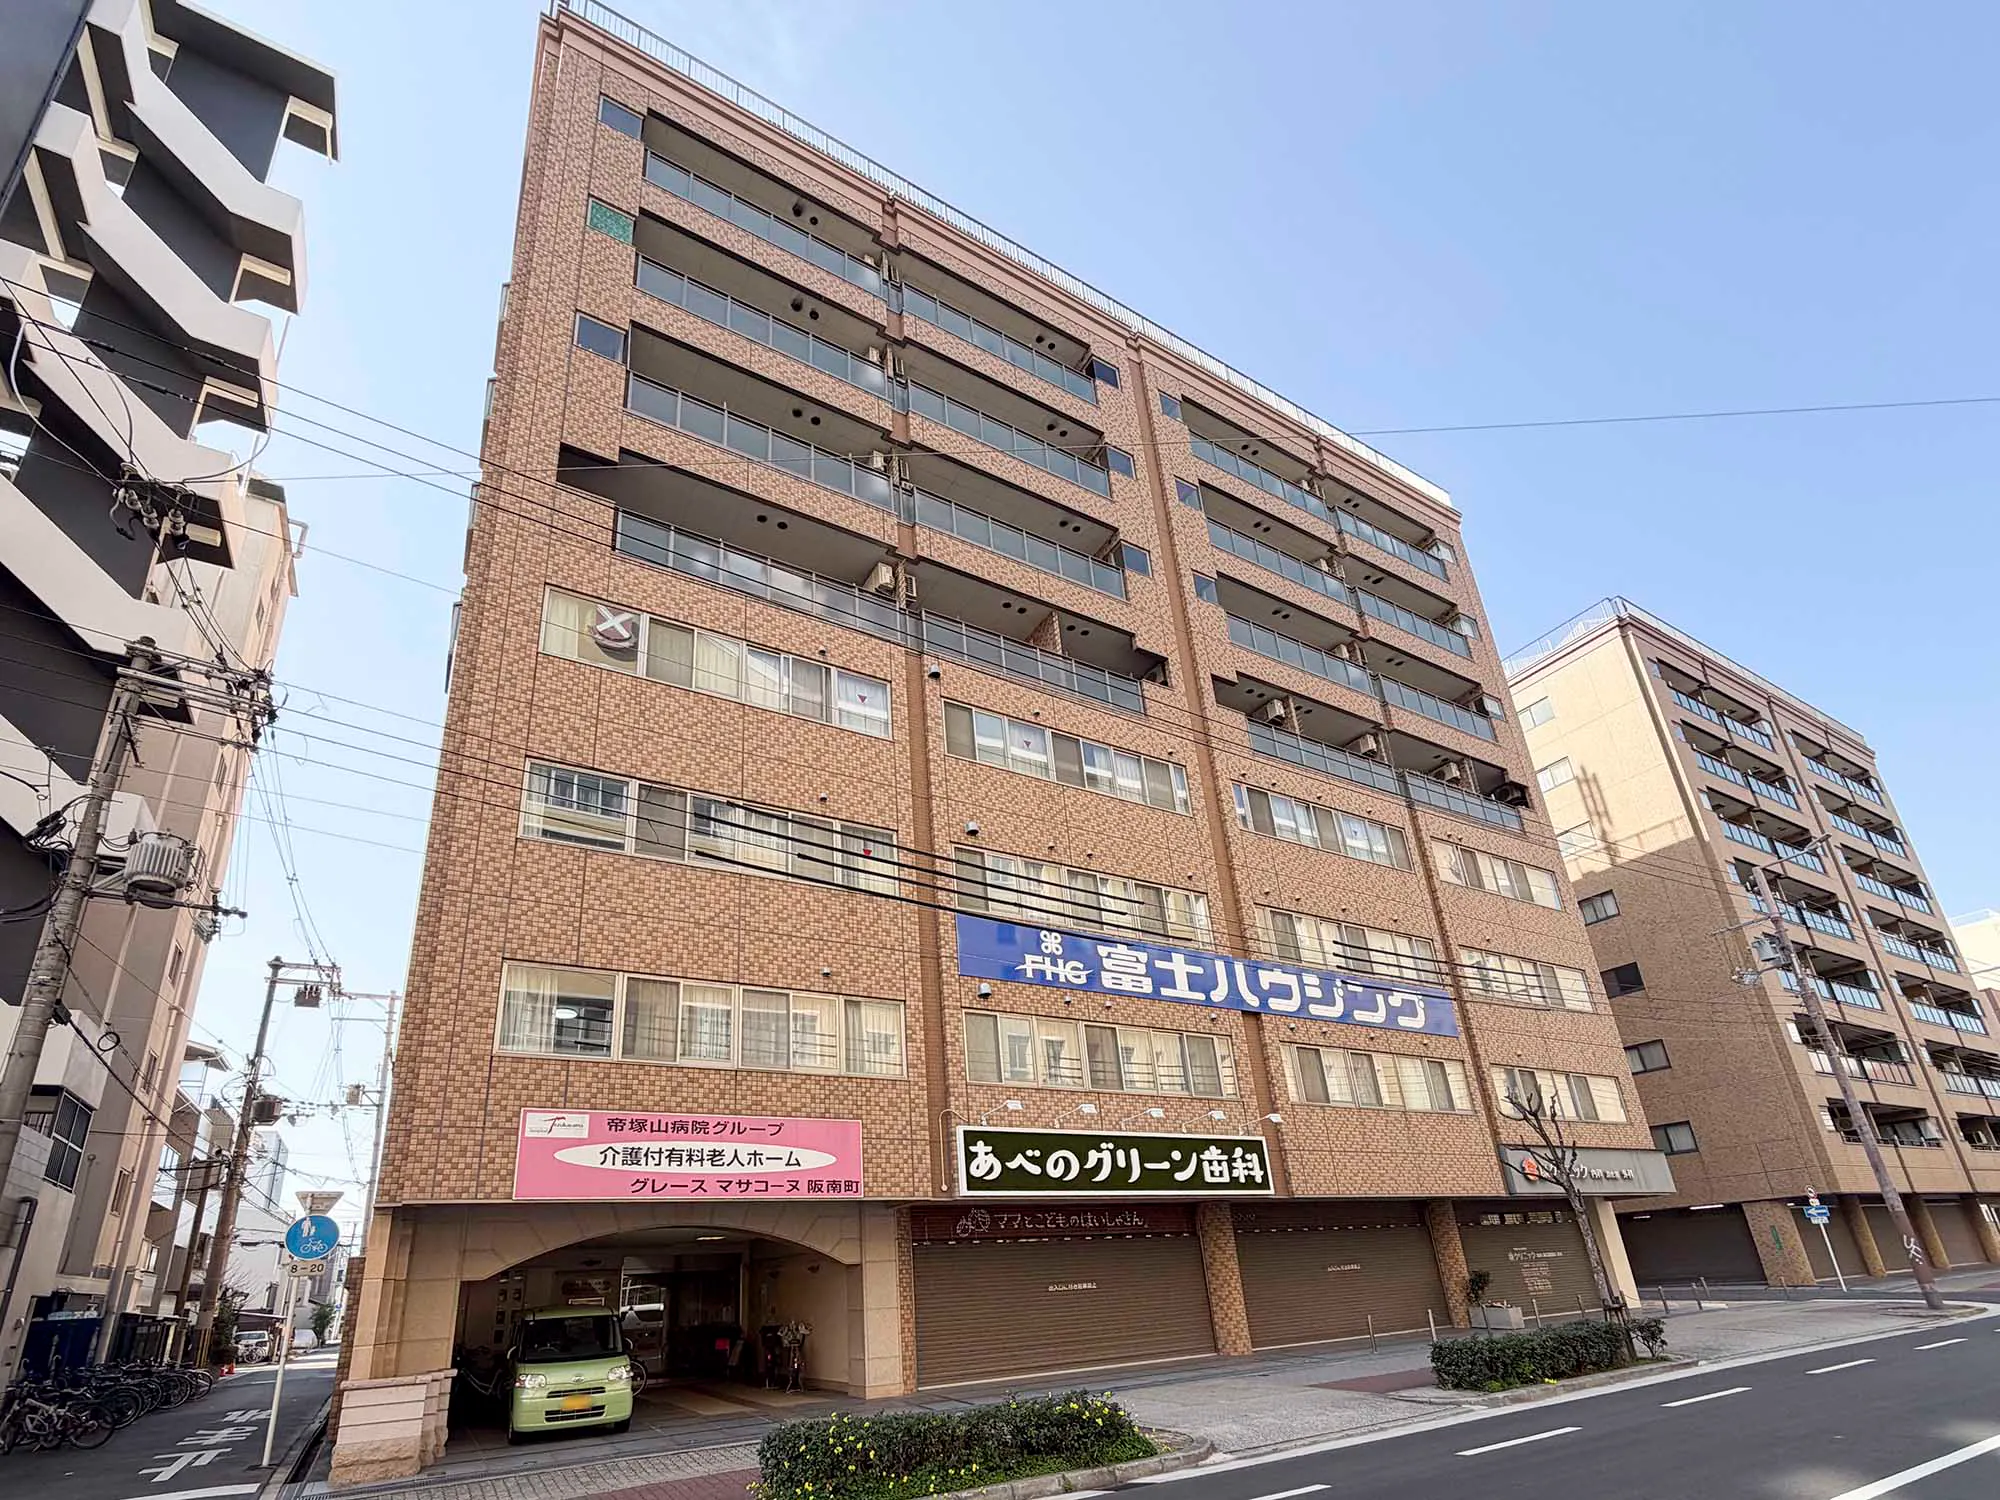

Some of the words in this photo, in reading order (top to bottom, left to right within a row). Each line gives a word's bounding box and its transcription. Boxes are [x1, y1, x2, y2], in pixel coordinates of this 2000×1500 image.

[1019, 953, 1091, 985] FHG
[1099, 943, 1426, 1029] 富士ハウジング
[606, 1117, 785, 1137] 帝塚山病院グループ
[599, 1146, 802, 1168] 介護付有料老人ホーム
[967, 1139, 1265, 1184] あべのグリーン歯科
[629, 1179, 707, 1195] グレース
[715, 1179, 801, 1195] マサコーヌ
[806, 1179, 861, 1195] 阪南町
